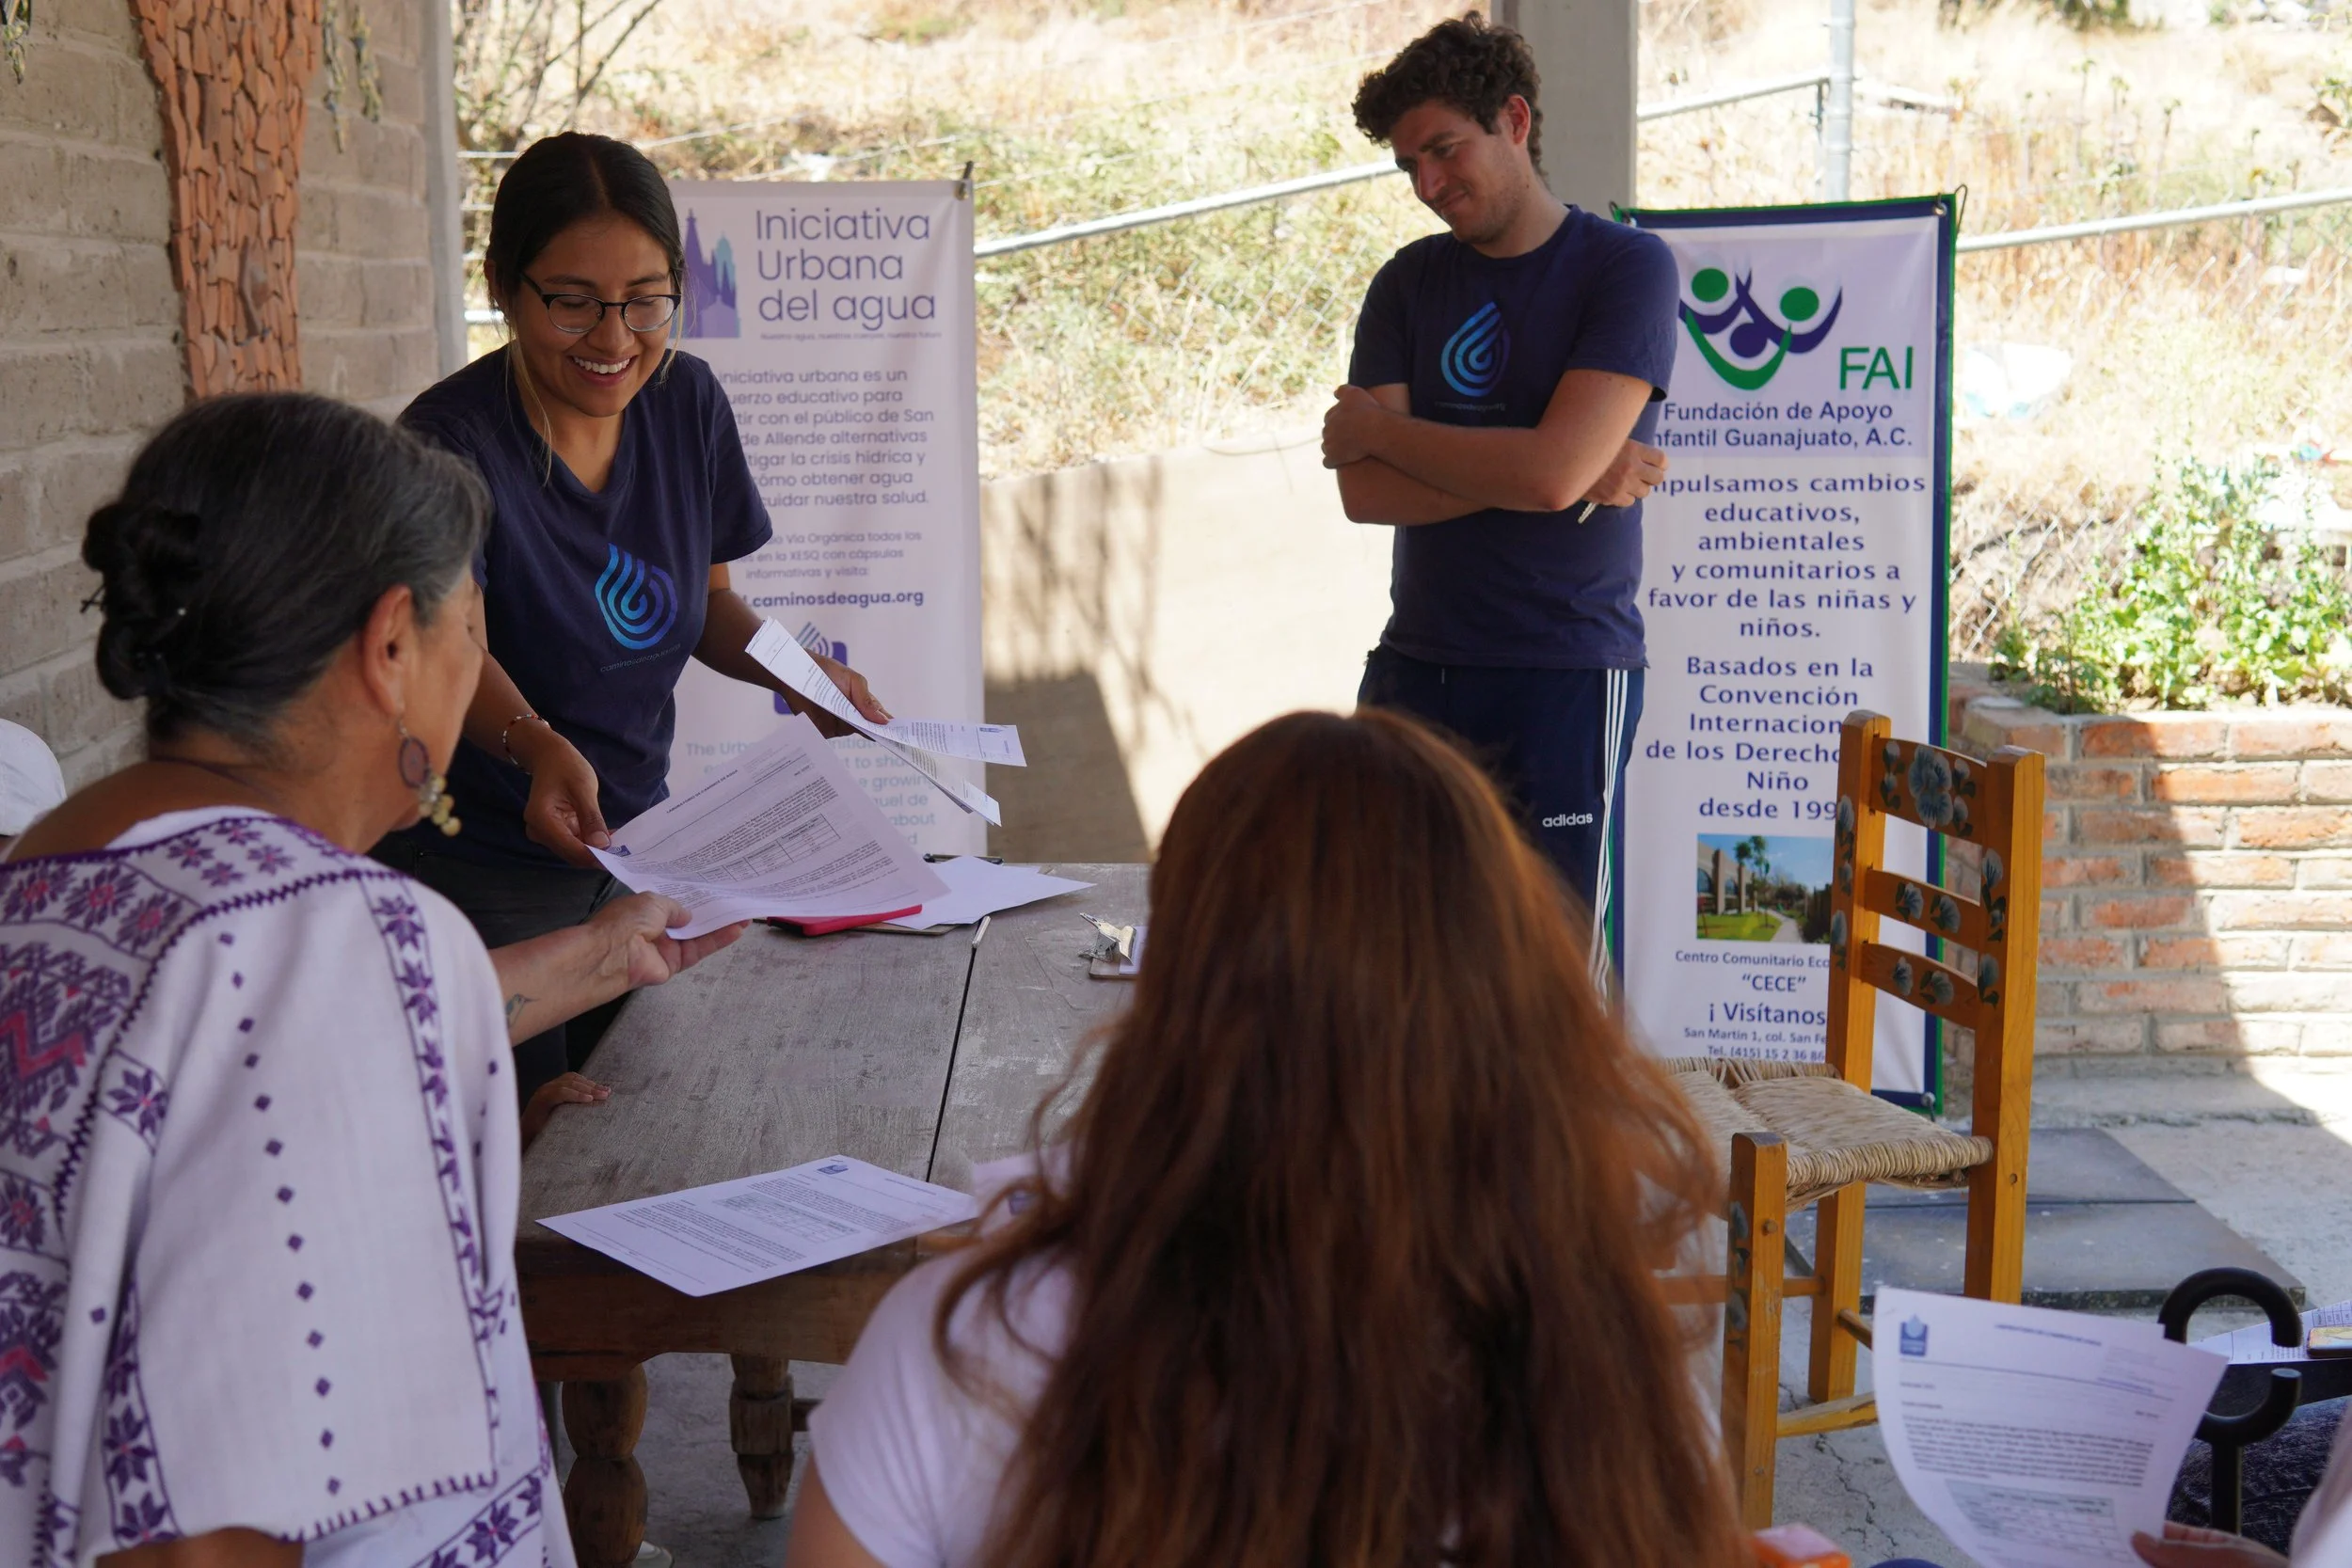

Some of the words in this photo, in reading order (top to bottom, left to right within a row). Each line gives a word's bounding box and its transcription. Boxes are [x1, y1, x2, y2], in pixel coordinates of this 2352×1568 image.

[755, 207, 930, 241] Iniciativa
[757, 247, 903, 281] Urbana
[757, 289, 818, 322] del
[832, 293, 936, 331] agua
[719, 370, 794, 385] iniciativa
[799, 369, 859, 384] urbana
[863, 372, 882, 382] es
[886, 370, 908, 382] un
[1838, 345, 1915, 390] FAI
[730, 392, 773, 405] uerzo
[776, 389, 860, 405] educativo
[863, 391, 903, 406] para
[758, 412, 790, 425] con
[794, 410, 809, 425] el
[813, 408, 874, 428] público
[878, 409, 899, 423] de
[903, 408, 934, 422] San
[1663, 401, 1779, 420] Fundación
[1786, 402, 1813, 420] de
[1819, 401, 1893, 424] Apoyo
[740, 432, 760, 446] de
[764, 432, 826, 446] Allende
[830, 430, 928, 444] alternativas
[1654, 428, 1717, 447] nfantil
[1724, 429, 1859, 451] Guanajuato,
[1866, 427, 1914, 447] A.C.
[747, 453, 786, 469] tigar
[790, 452, 806, 466] la
[810, 451, 850, 466] crisis
[916, 452, 926, 466] y
[802, 472, 864, 487] obtener
[869, 472, 914, 488] agua
[1654, 473, 1799, 497] pulsamos
[1810, 472, 1926, 493] cambios
[814, 492, 877, 507] nuestra
[882, 490, 930, 505] salud.
[1704, 501, 1861, 525] educativos,
[1697, 531, 1866, 551] ambientales
[822, 551, 845, 562] con
[1671, 563, 1686, 583] y
[1694, 561, 1877, 580] comunitarios
[1886, 564, 1900, 580] a
[743, 592, 924, 609] .caminosdeagua.org
[1648, 587, 1718, 608] favor
[1726, 588, 1758, 609] de
[1769, 588, 1805, 609] las
[1818, 589, 1891, 610] niñas
[1901, 594, 1917, 614] y
[1740, 617, 1821, 638] niños.
[1687, 656, 1797, 677] Basados
[1807, 660, 1839, 677] en
[1851, 657, 1874, 678] la
[1699, 684, 1859, 706] Convención
[1690, 713, 1842, 735] Internacion
[685, 742, 716, 757] The
[720, 740, 751, 756] Urb
[1646, 739, 1676, 760] de
[1687, 740, 1724, 761] los
[854, 755, 871, 769] to
[876, 754, 909, 768] sha
[1747, 770, 1809, 792] Niño
[874, 791, 904, 807] uel
[907, 790, 929, 806] de
[1699, 798, 1779, 819] desde
[1791, 800, 1836, 821] 199
[1542, 813, 1594, 828] adidas
[1675, 949, 1719, 965] Centro
[1722, 951, 1805, 968] Comunitario
[1808, 956, 1830, 969] Eco
[1684, 1026, 1705, 1039] San
[1765, 1031, 1786, 1043] col.
[1789, 1033, 1812, 1044] San
[1815, 1034, 1827, 1045] Fe
[1708, 1045, 1727, 1056] Tel.
